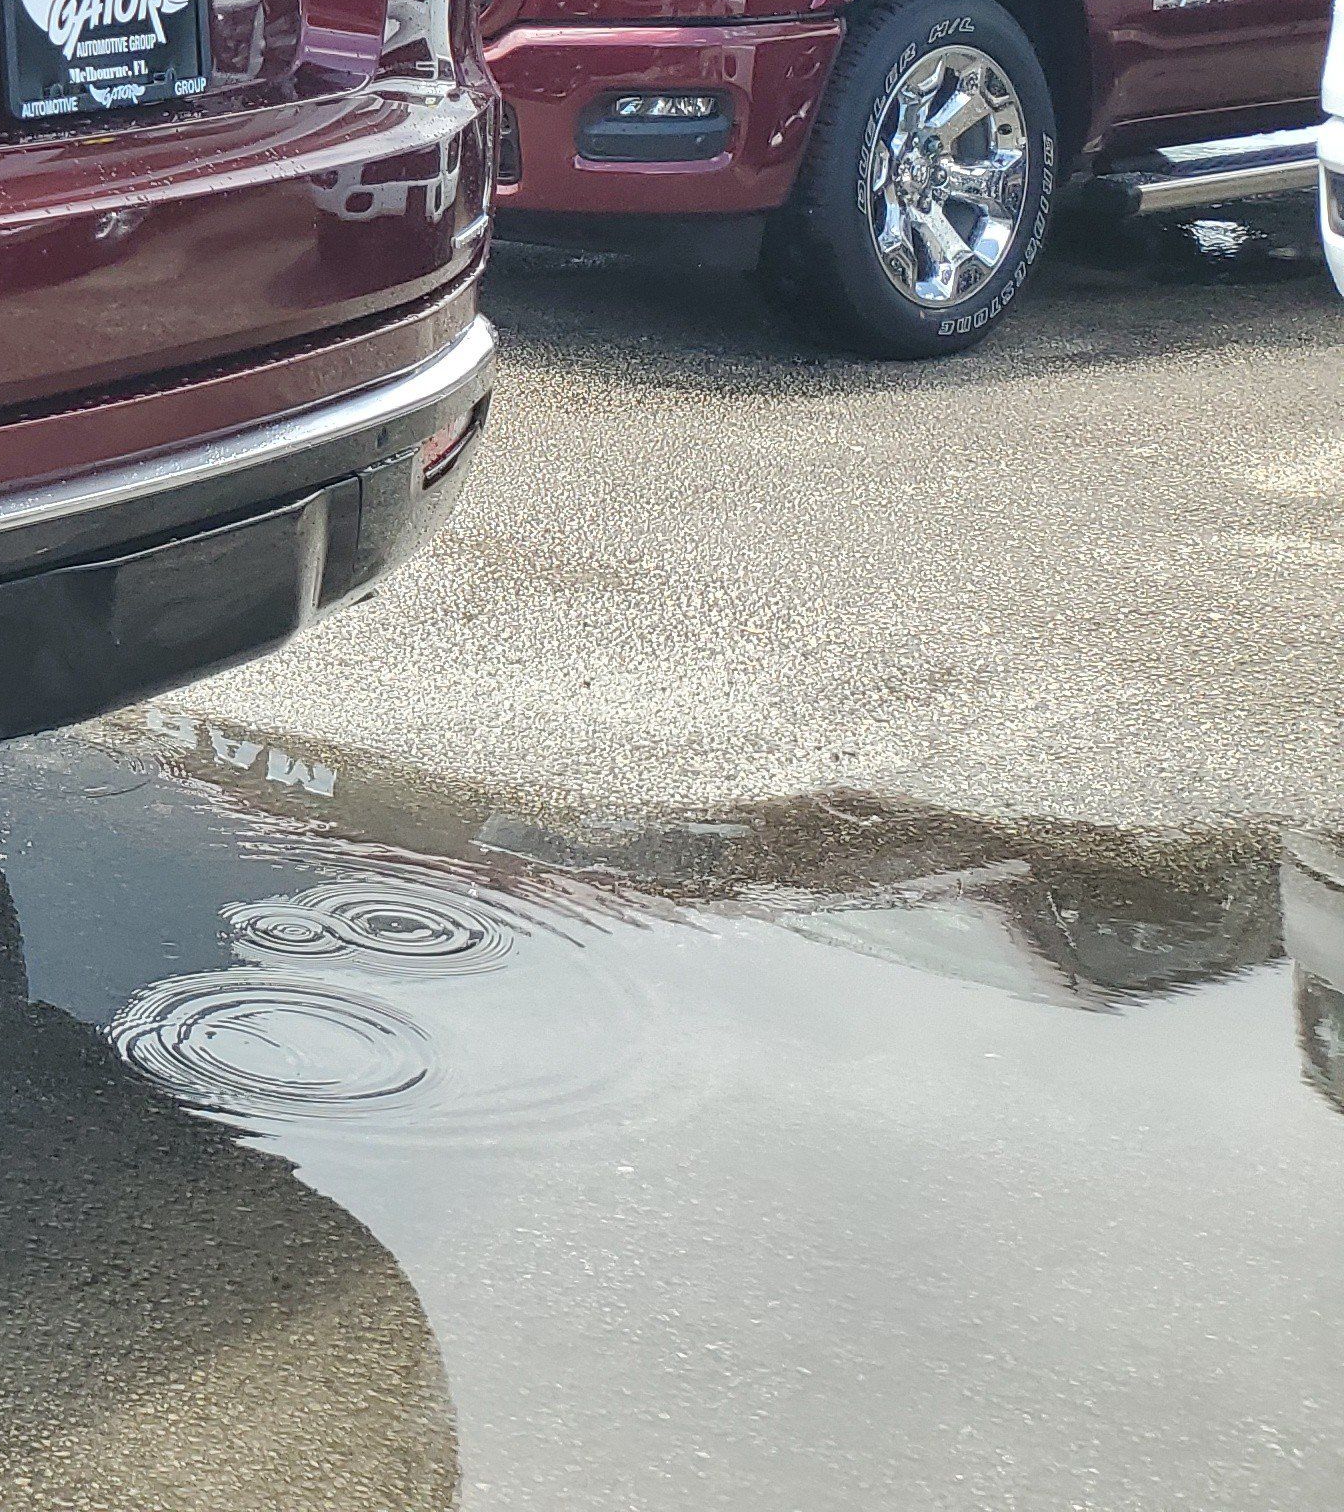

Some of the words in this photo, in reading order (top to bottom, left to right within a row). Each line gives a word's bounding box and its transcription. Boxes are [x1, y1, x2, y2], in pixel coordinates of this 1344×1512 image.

[76, 37, 128, 57] AUTOMOTIVE
[129, 34, 156, 51] GROUP
[133, 60, 148, 77] FL
[21, 96, 79, 118] AUTOMOTIVE
[174, 77, 207, 96] GROUP
